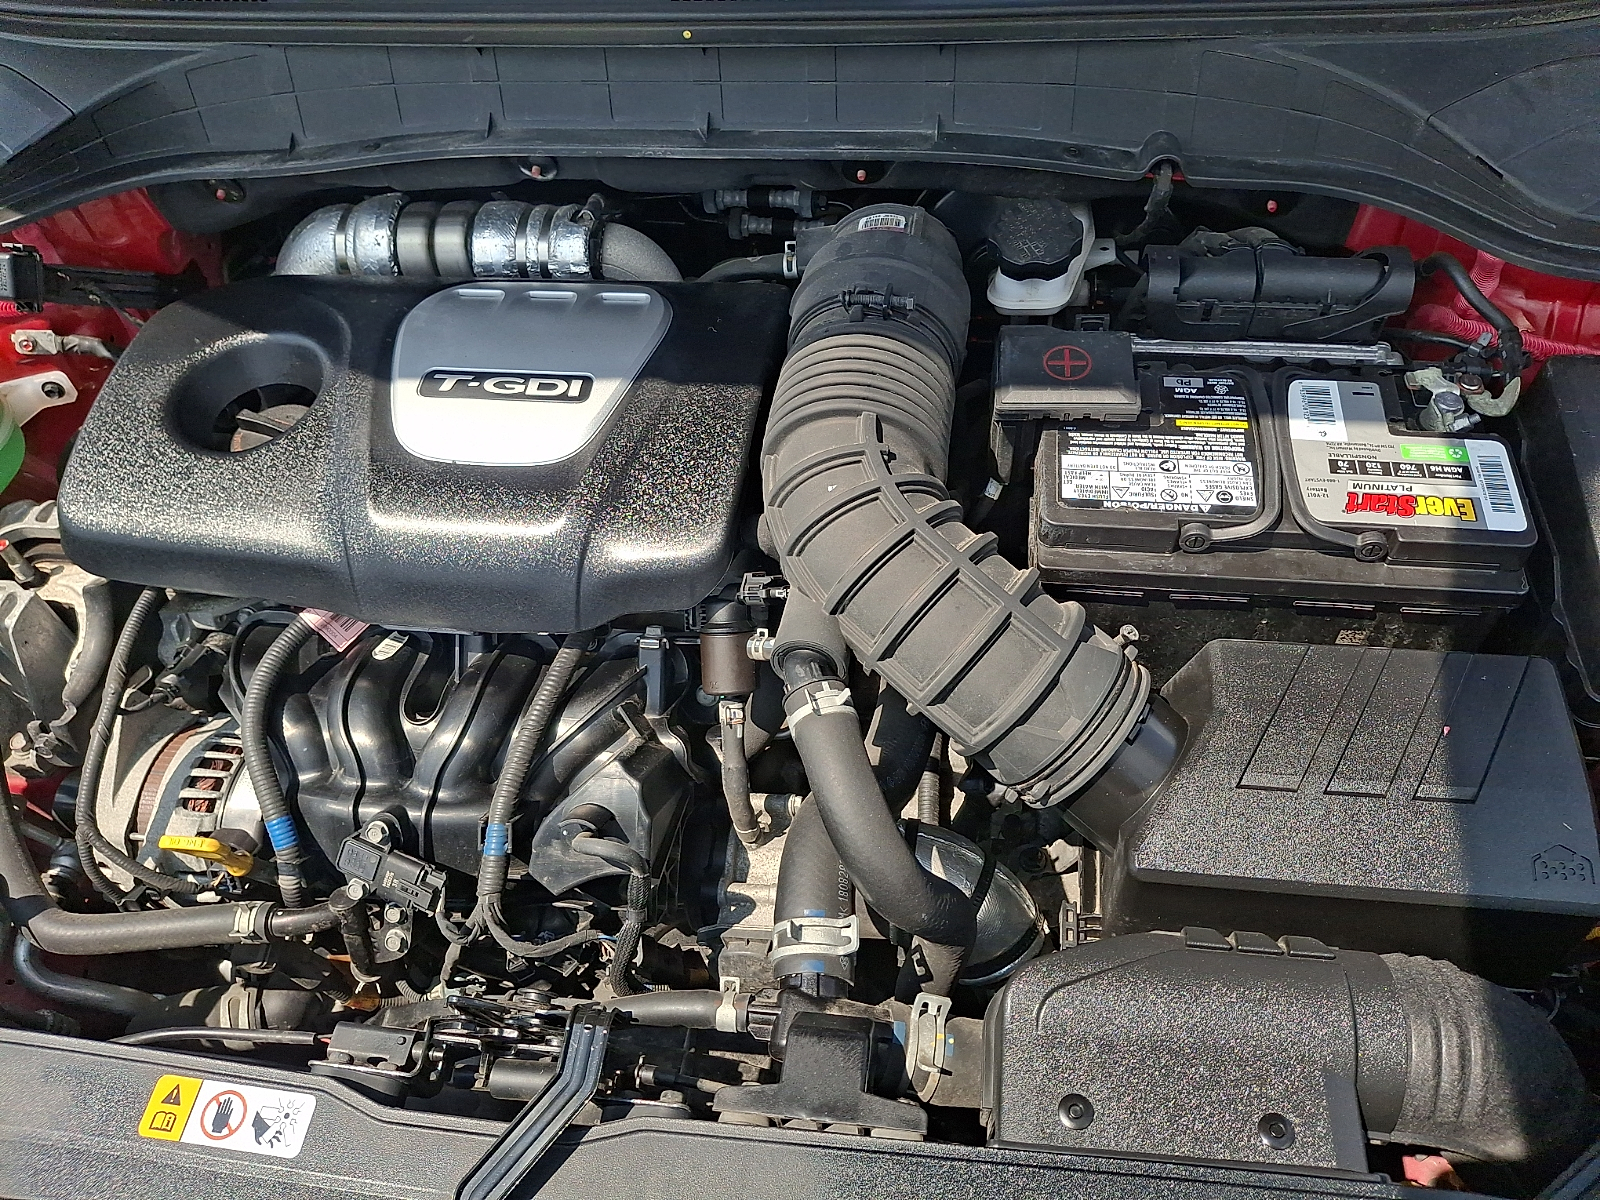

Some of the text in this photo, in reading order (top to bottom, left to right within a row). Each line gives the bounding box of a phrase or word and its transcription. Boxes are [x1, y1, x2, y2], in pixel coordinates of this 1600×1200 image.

[433, 374, 584, 398] T-GDI
[1353, 483, 1413, 491] PLATINUM
[1346, 492, 1477, 522] EverStart
